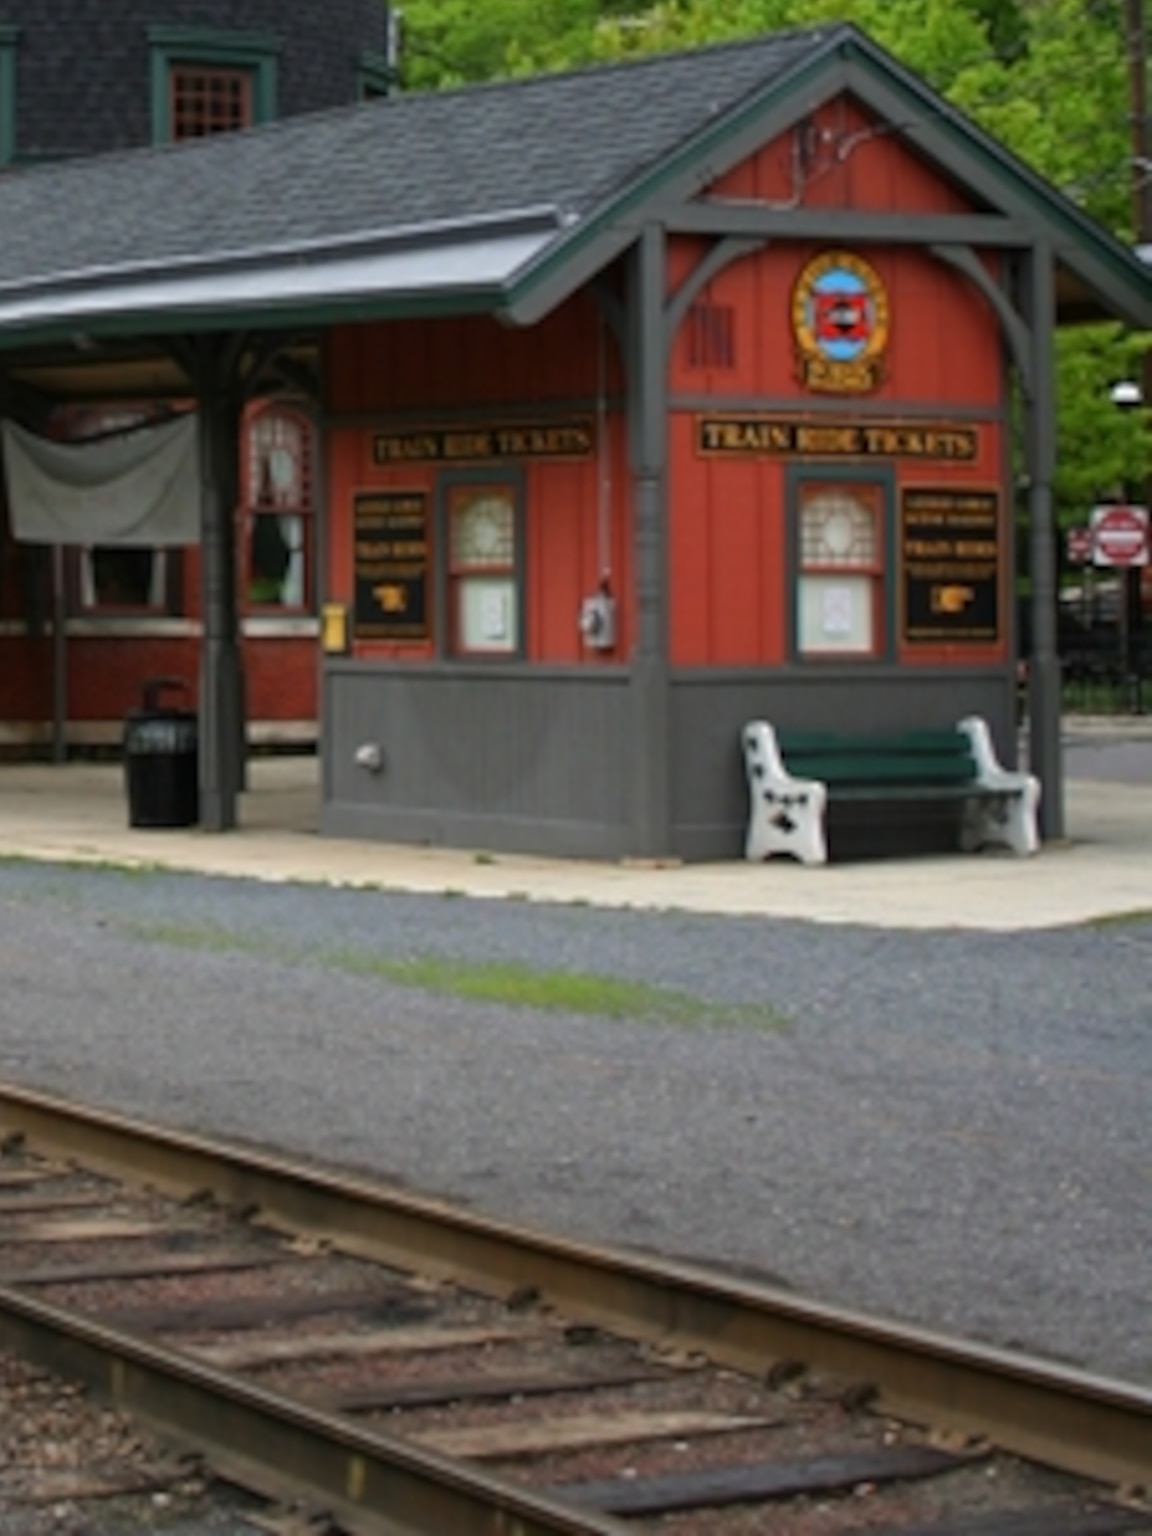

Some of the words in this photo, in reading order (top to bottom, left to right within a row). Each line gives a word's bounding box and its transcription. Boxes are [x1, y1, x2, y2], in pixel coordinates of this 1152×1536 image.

[375, 434, 437, 462] TRAIN
[443, 431, 489, 458] RIDE
[497, 427, 591, 455] TICKETS
[704, 422, 790, 449] TRAIN
[797, 426, 860, 454] RIDE
[864, 428, 975, 459] TICKETS
